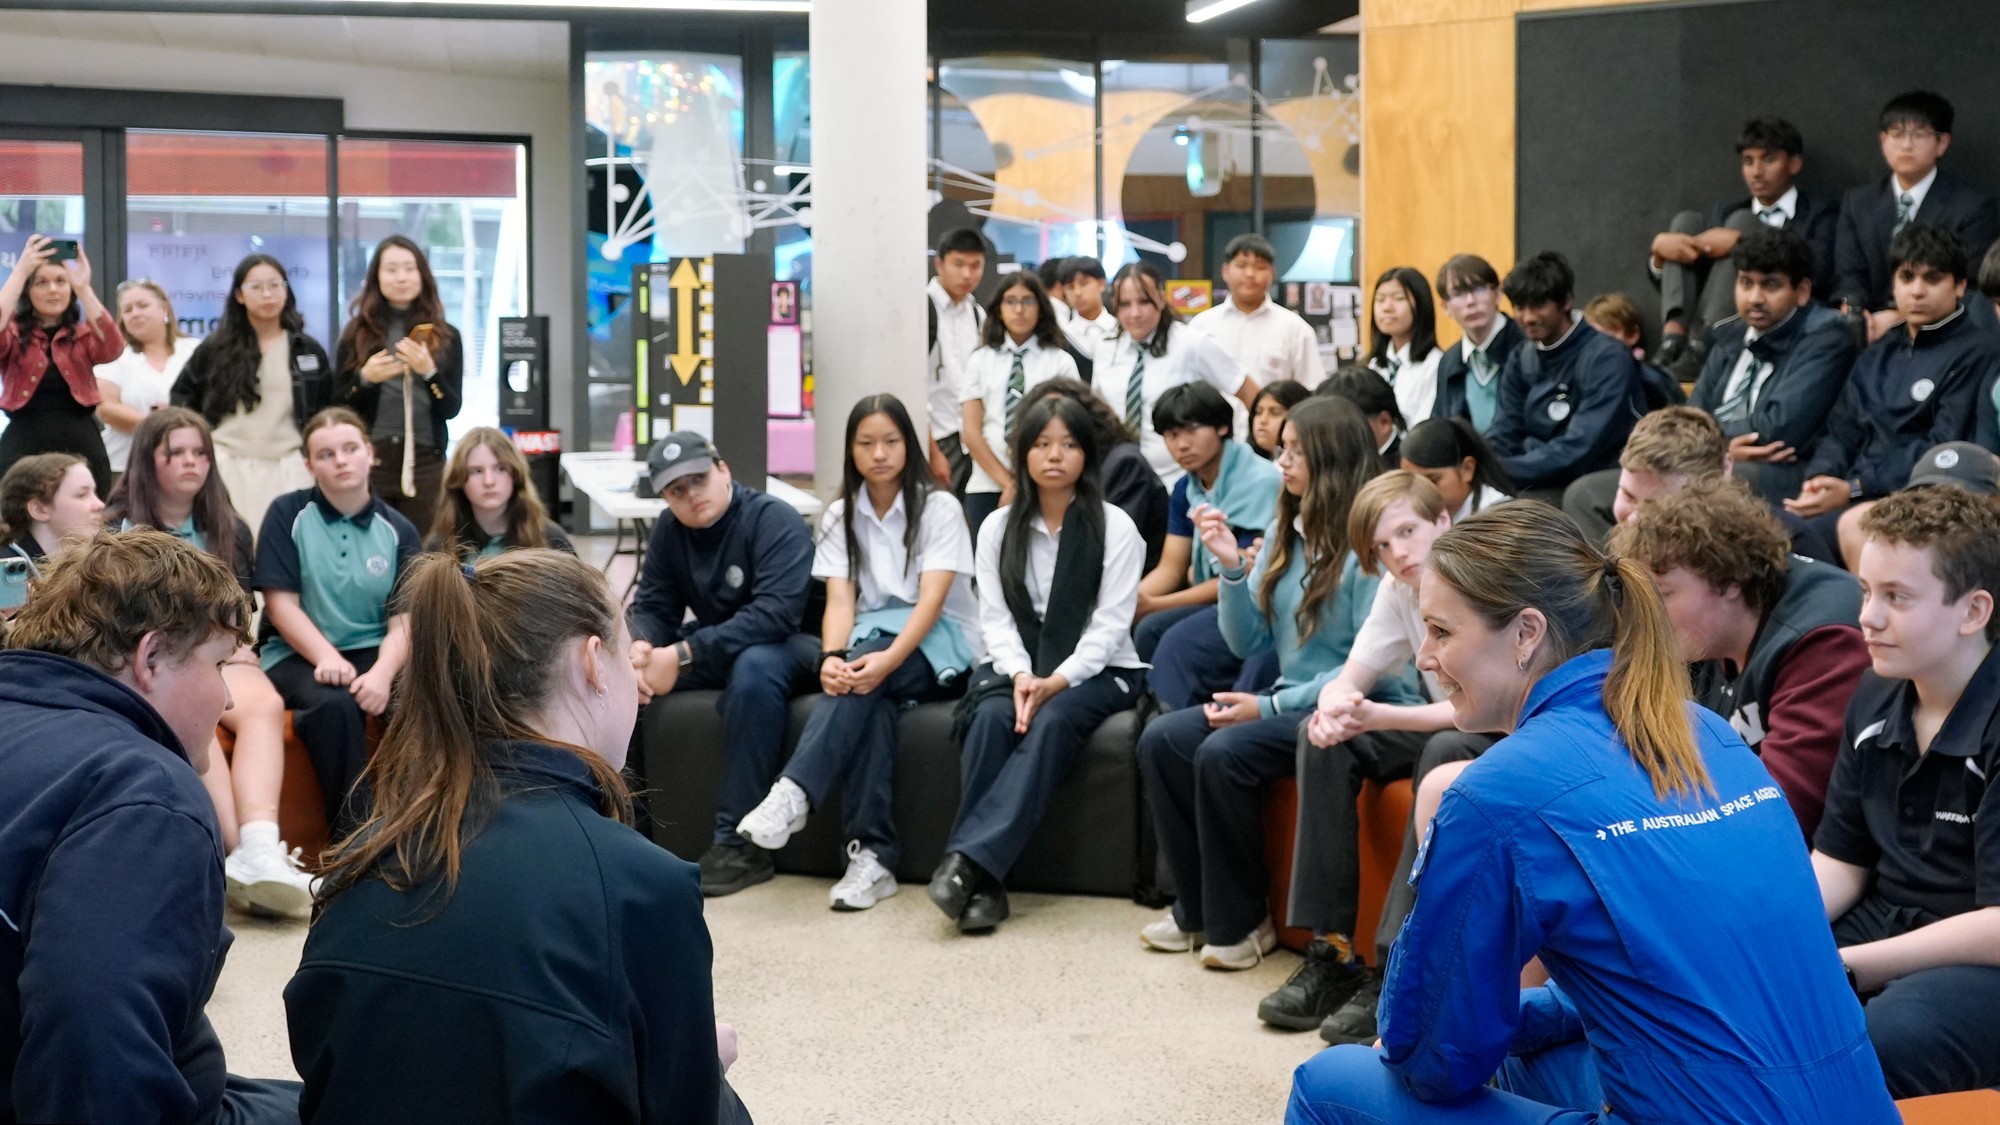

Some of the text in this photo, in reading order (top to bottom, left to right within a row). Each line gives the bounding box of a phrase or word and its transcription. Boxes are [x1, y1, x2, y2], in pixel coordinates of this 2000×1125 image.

[1607, 820, 1638, 837] THE
[1642, 808, 1721, 831] AUSTRALIAN
[1720, 794, 1756, 817] SPACE
